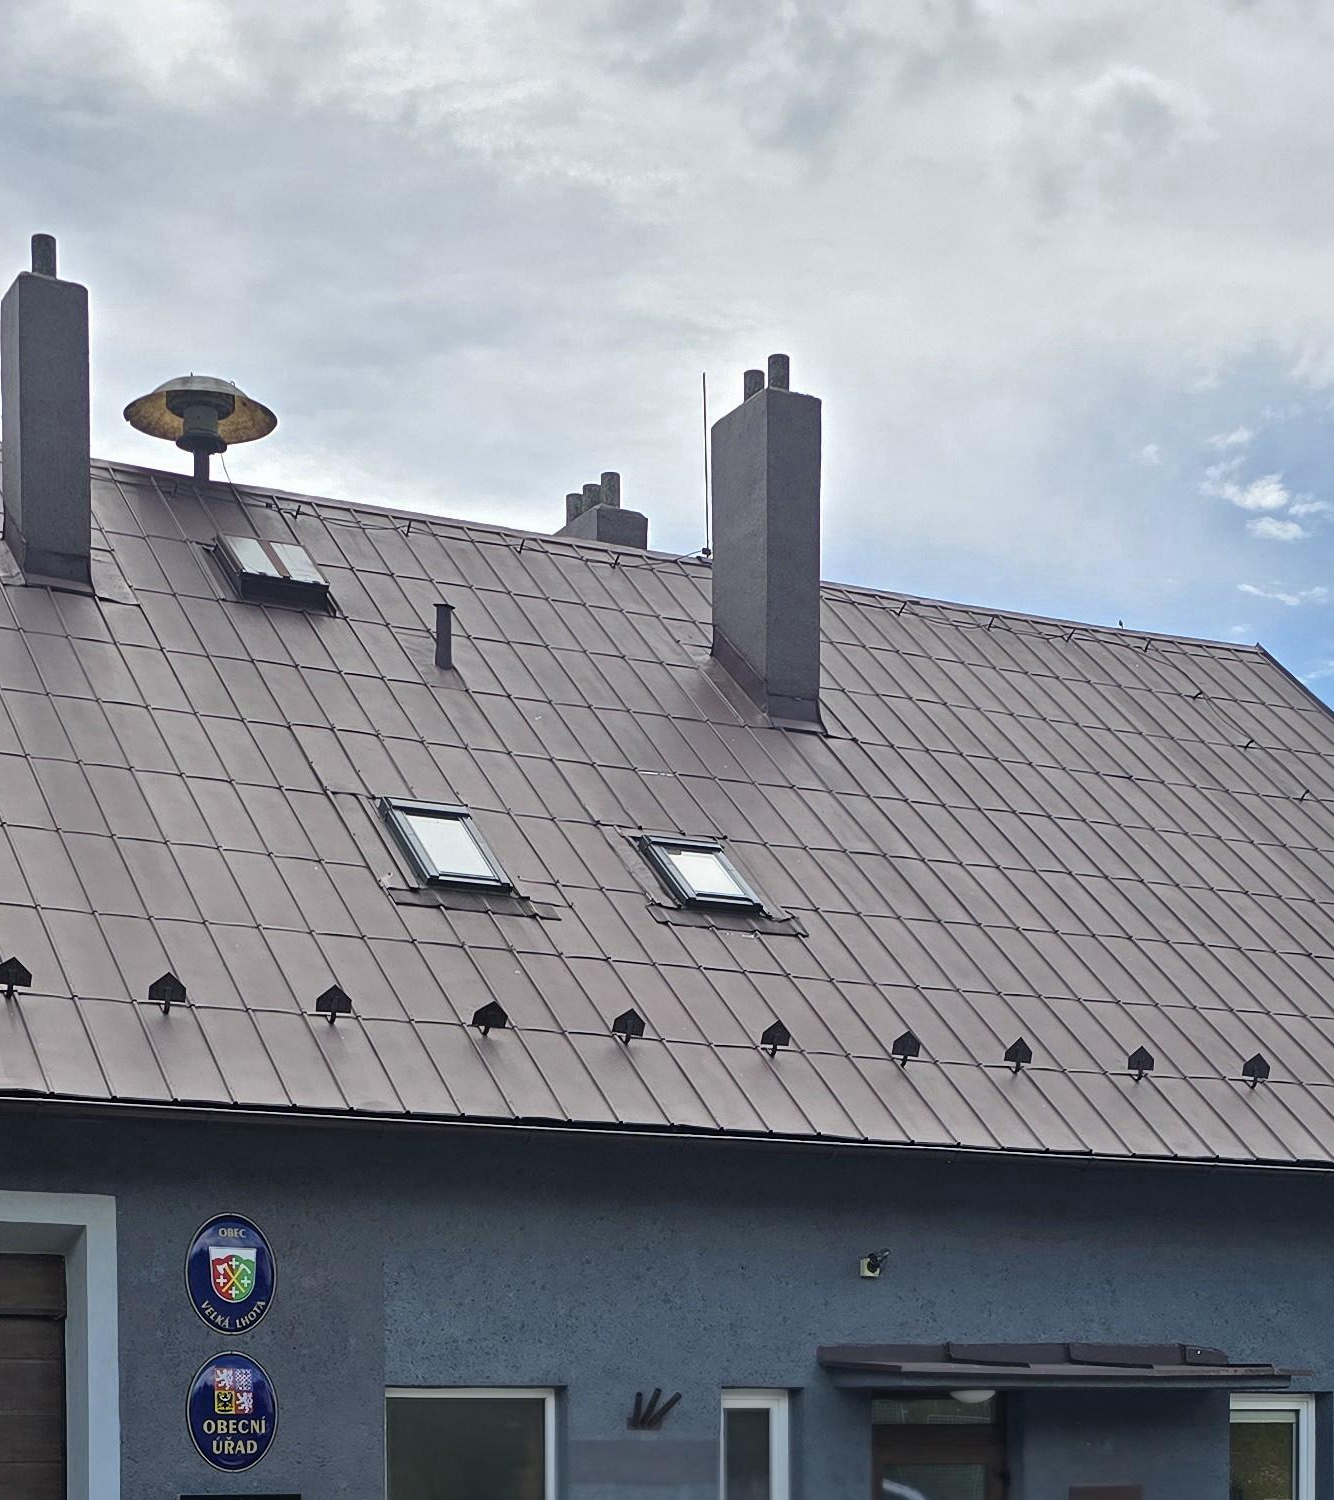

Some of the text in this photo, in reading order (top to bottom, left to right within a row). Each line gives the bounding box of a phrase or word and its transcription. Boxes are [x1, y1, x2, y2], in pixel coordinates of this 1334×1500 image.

[218, 1228, 247, 1238] OBEC
[200, 1300, 267, 1329] VELKÁ LHOTA
[202, 1415, 267, 1434] OBECNÍ
[212, 1436, 258, 1455] ÚŘAD
